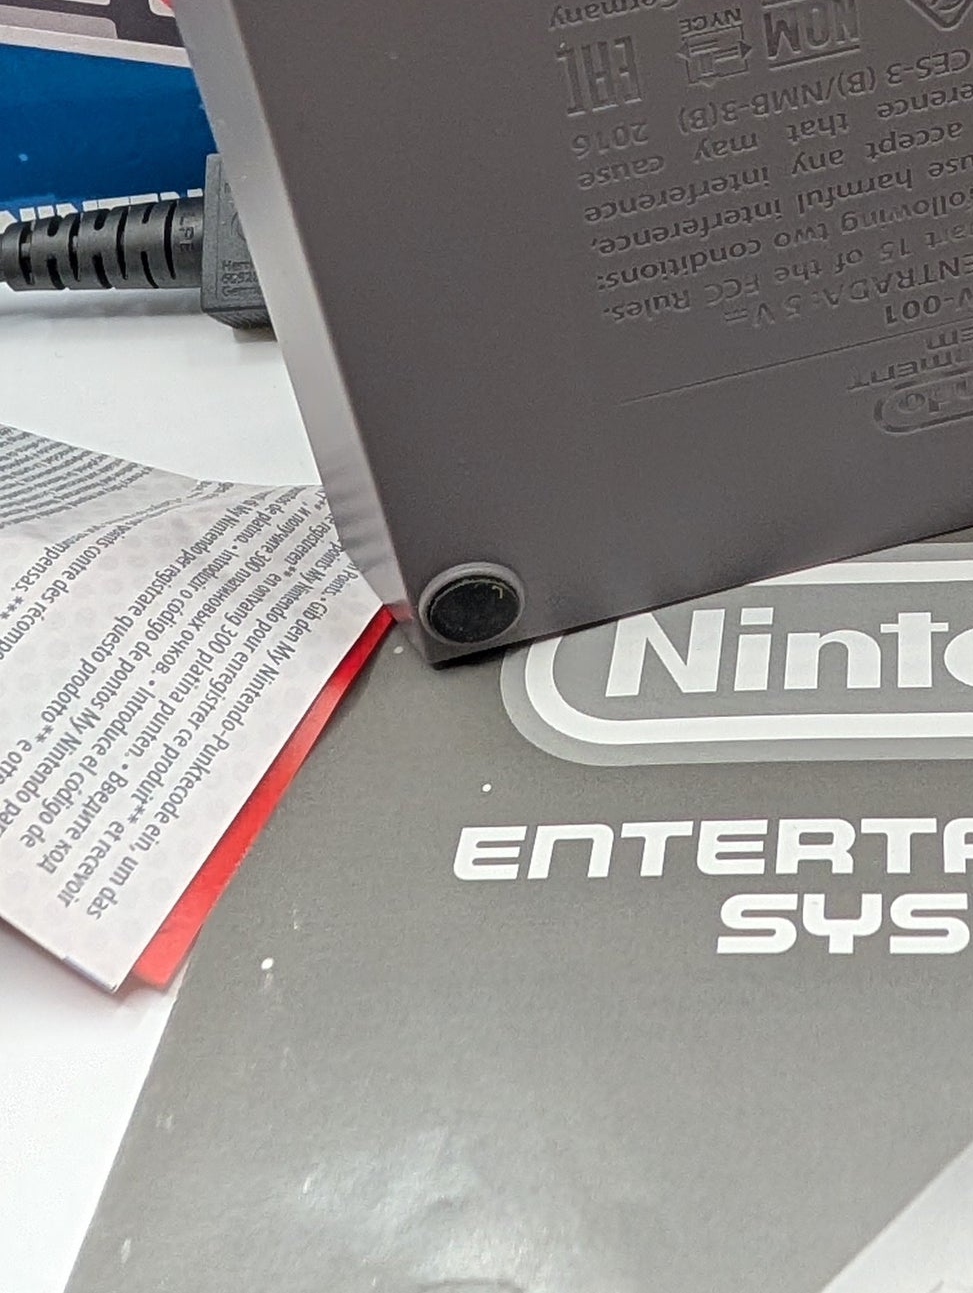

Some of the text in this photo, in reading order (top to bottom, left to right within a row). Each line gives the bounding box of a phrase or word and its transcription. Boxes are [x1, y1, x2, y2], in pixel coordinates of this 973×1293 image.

[678, 5, 741, 34] NYCE
[571, 119, 649, 160] 2016
[691, 127, 756, 163] may
[786, 110, 847, 145] that
[865, 115, 961, 162] accept
[578, 153, 663, 190] cause
[790, 144, 843, 175] any
[583, 164, 769, 229] interference
[797, 167, 911, 215] harmful
[840, 181, 973, 239] following
[590, 194, 780, 264] interference,
[774, 221, 827, 251] two
[596, 235, 761, 295] conditions:
[831, 247, 862, 274] of
[879, 237, 908, 261] 15
[704, 272, 758, 304] FCC
[774, 257, 821, 288] the
[602, 287, 689, 329] Rules.
[191, 515, 240, 554] Nintendo
[62, 546, 100, 580] contre
[175, 549, 196, 568] per
[187, 549, 239, 592] Introduzir
[245, 550, 272, 573] 300
[41, 580, 69, 603] des
[128, 564, 181, 616] registrare
[180, 589, 193, 599] o
[266, 573, 282, 588] en
[188, 568, 251, 631] платиновых
[224, 585, 270, 626] ontvang
[266, 582, 314, 623] Nintendo
[302, 602, 328, 620] Gib
[145, 598, 185, 641] código
[243, 618, 272, 654] pour
[284, 619, 312, 643] den
[91, 615, 134, 662] questo
[128, 641, 152, 661] de
[151, 630, 195, 674] очков.
[208, 624, 238, 654] 300
[267, 641, 296, 666] My
[90, 657, 135, 710] pontos
[169, 648, 214, 703] platina
[188, 651, 249, 730] enregistrer
[69, 707, 101, 734] My
[91, 686, 155, 756] Introduce
[124, 699, 176, 757] punten.
[173, 728, 192, 747] ce
[16, 740, 32, 752] e
[154, 664, 280, 824] Nintendo-Punktecode
[16, 732, 82, 803] Nintendo
[78, 755, 98, 776] el
[39, 772, 85, 824] código
[66, 771, 128, 840] Введите
[20, 824, 46, 848] de
[104, 820, 125, 842] et
[129, 824, 161, 851] ein,
[36, 839, 72, 874] код
[57, 839, 112, 908] recevoir
[109, 857, 139, 886] um
[87, 887, 118, 920] das
